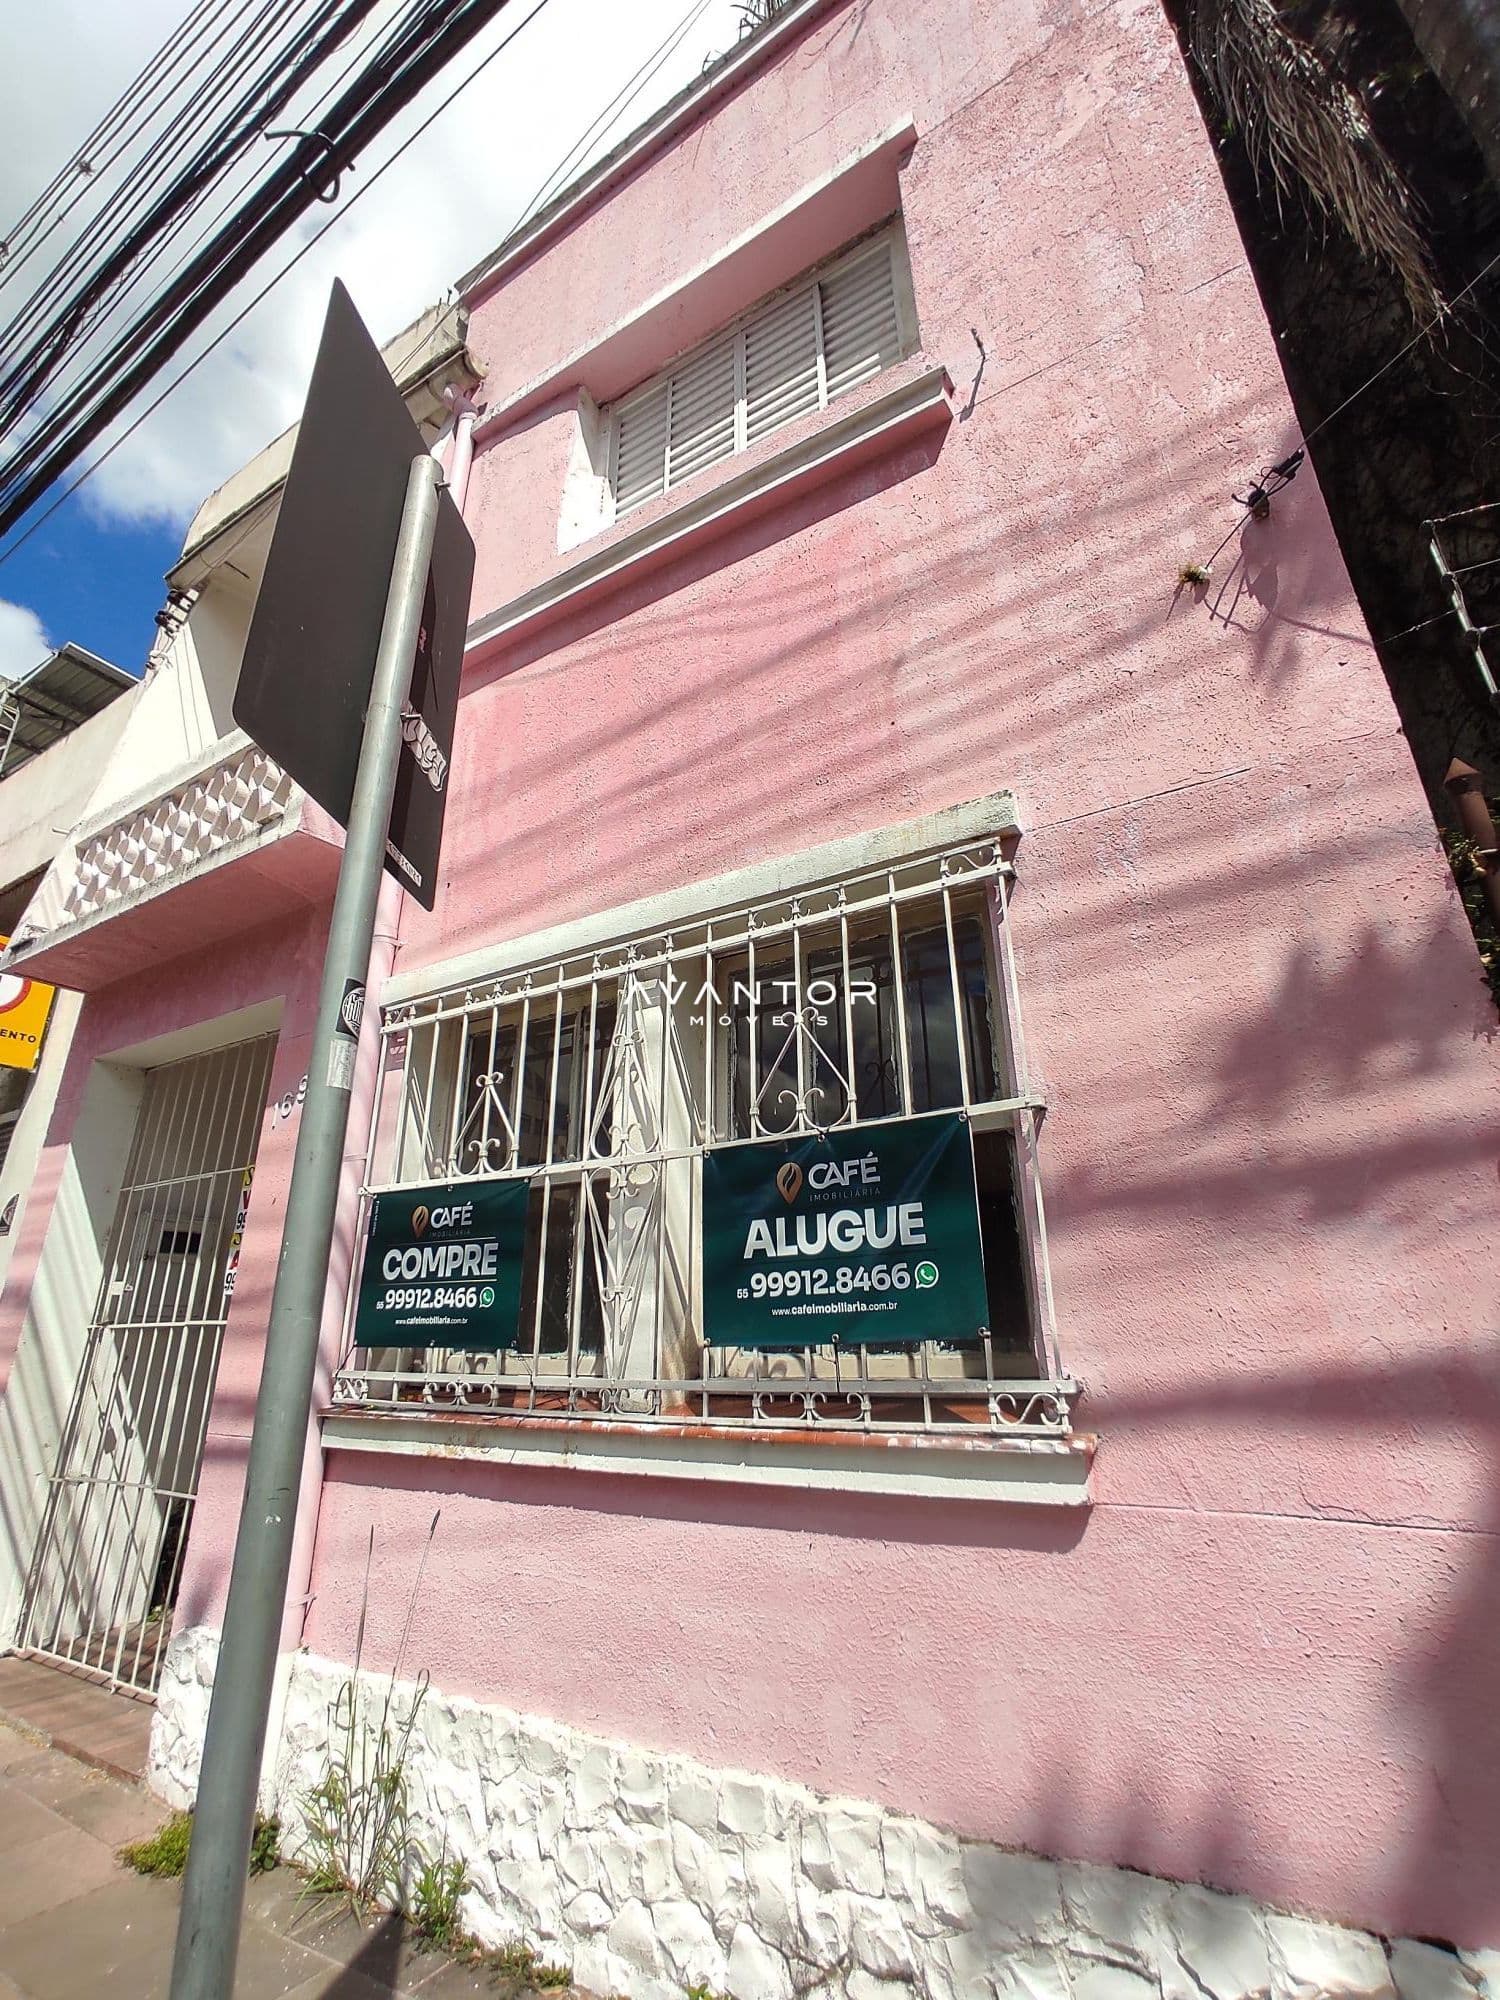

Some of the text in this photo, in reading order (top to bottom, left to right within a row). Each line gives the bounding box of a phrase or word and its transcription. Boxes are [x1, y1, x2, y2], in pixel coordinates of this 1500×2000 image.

[808, 1151, 881, 1190] CAFÉ
[430, 1201, 474, 1229] CAFÉ
[743, 1202, 927, 1259] ALUGUE
[382, 1243, 499, 1280] COMPRE
[385, 1286, 478, 1310] 99912.8466
[736, 1262, 911, 1299] 55 99912.8466
[771, 1302, 898, 1316] www.cafeimobiliaria.com.br
